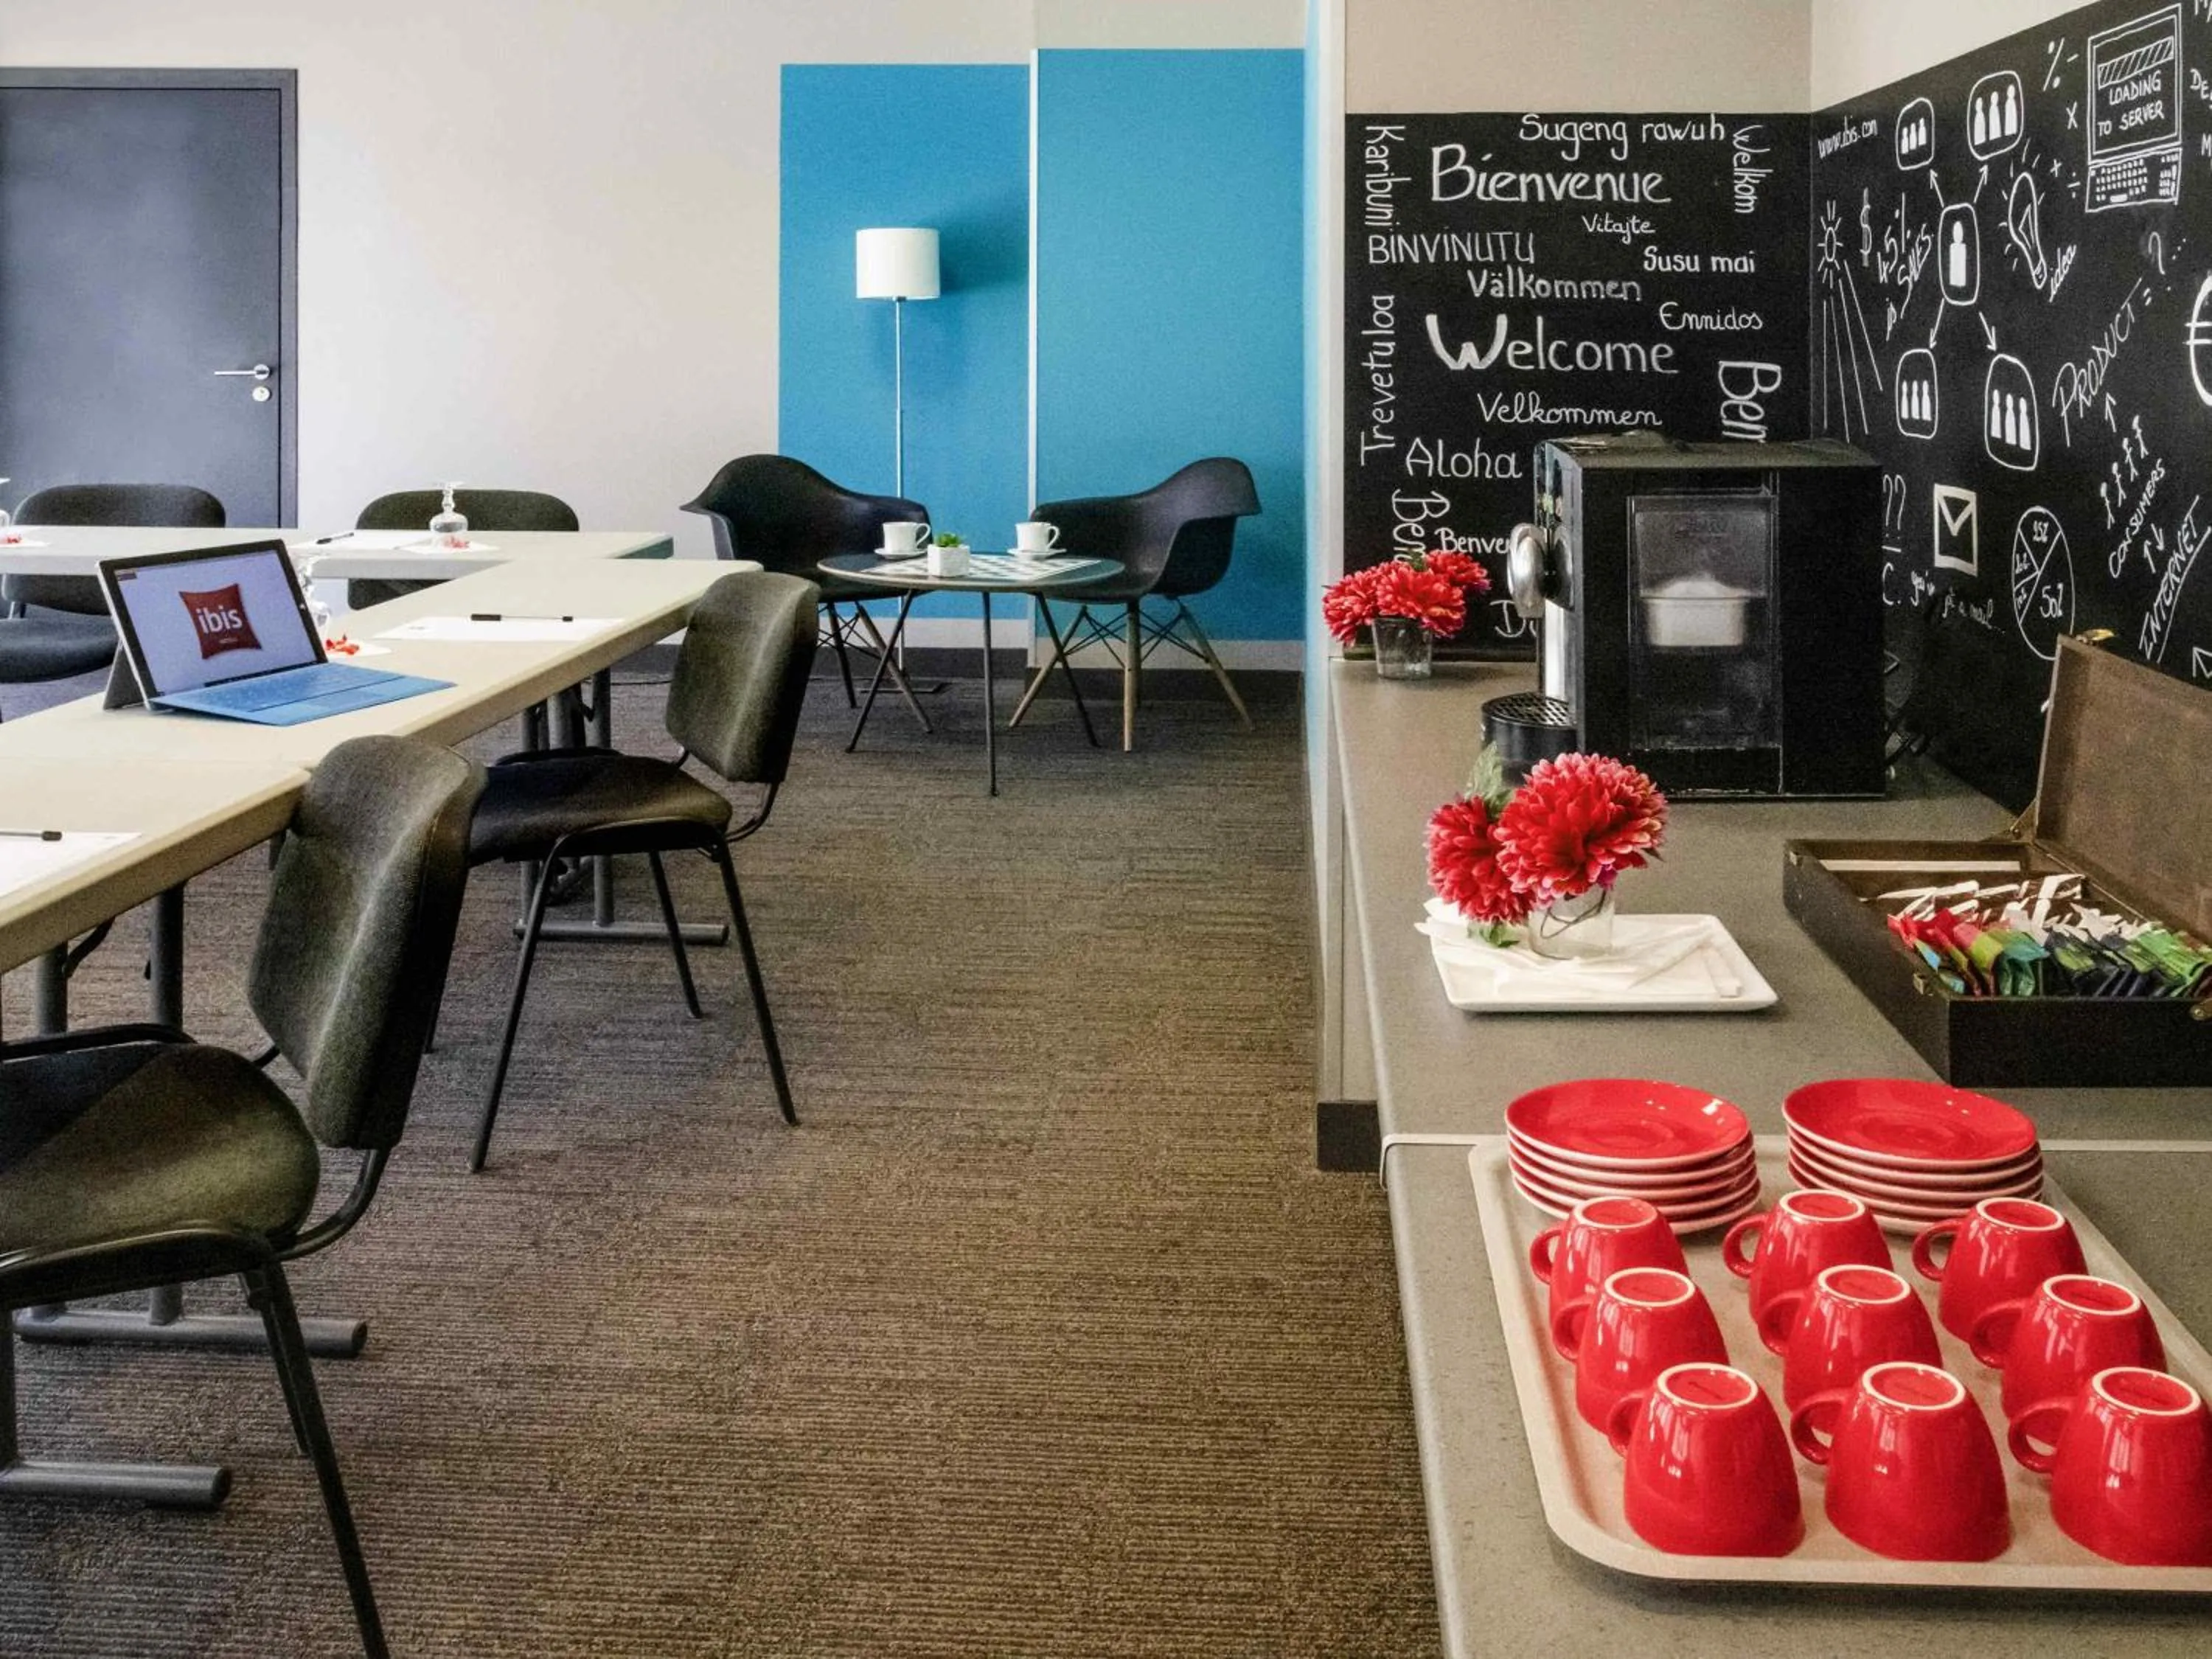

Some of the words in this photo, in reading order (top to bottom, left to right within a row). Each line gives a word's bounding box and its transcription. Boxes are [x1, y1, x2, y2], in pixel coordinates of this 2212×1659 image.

[2107, 68, 2163, 107] LOADING
[1519, 113, 1629, 161] Sugeng
[1641, 113, 1725, 142] rawuh
[2097, 119, 2112, 137] TO
[2117, 98, 2165, 131] SERVER
[1364, 125, 1412, 226] Karibuni
[1431, 141, 1672, 203] Bienvenue
[1732, 125, 1773, 213] Welkom
[1582, 212, 1655, 245] Vitajte
[1467, 266, 1641, 302] Välkommen
[1644, 245, 1700, 272] Susu
[1711, 250, 1755, 273] mai
[2048, 244, 2077, 303] idea
[1425, 313, 1679, 373] Welcome
[2051, 276, 2142, 448] PRODUCT
[1477, 391, 1663, 425] Velkommen
[1717, 355, 1783, 443] Ben
[1405, 437, 1523, 479] Aloha
[2109, 457, 2166, 579] CONSUMERS
[2138, 493, 2199, 661] INTERNET
[195, 605, 244, 636] ibis
